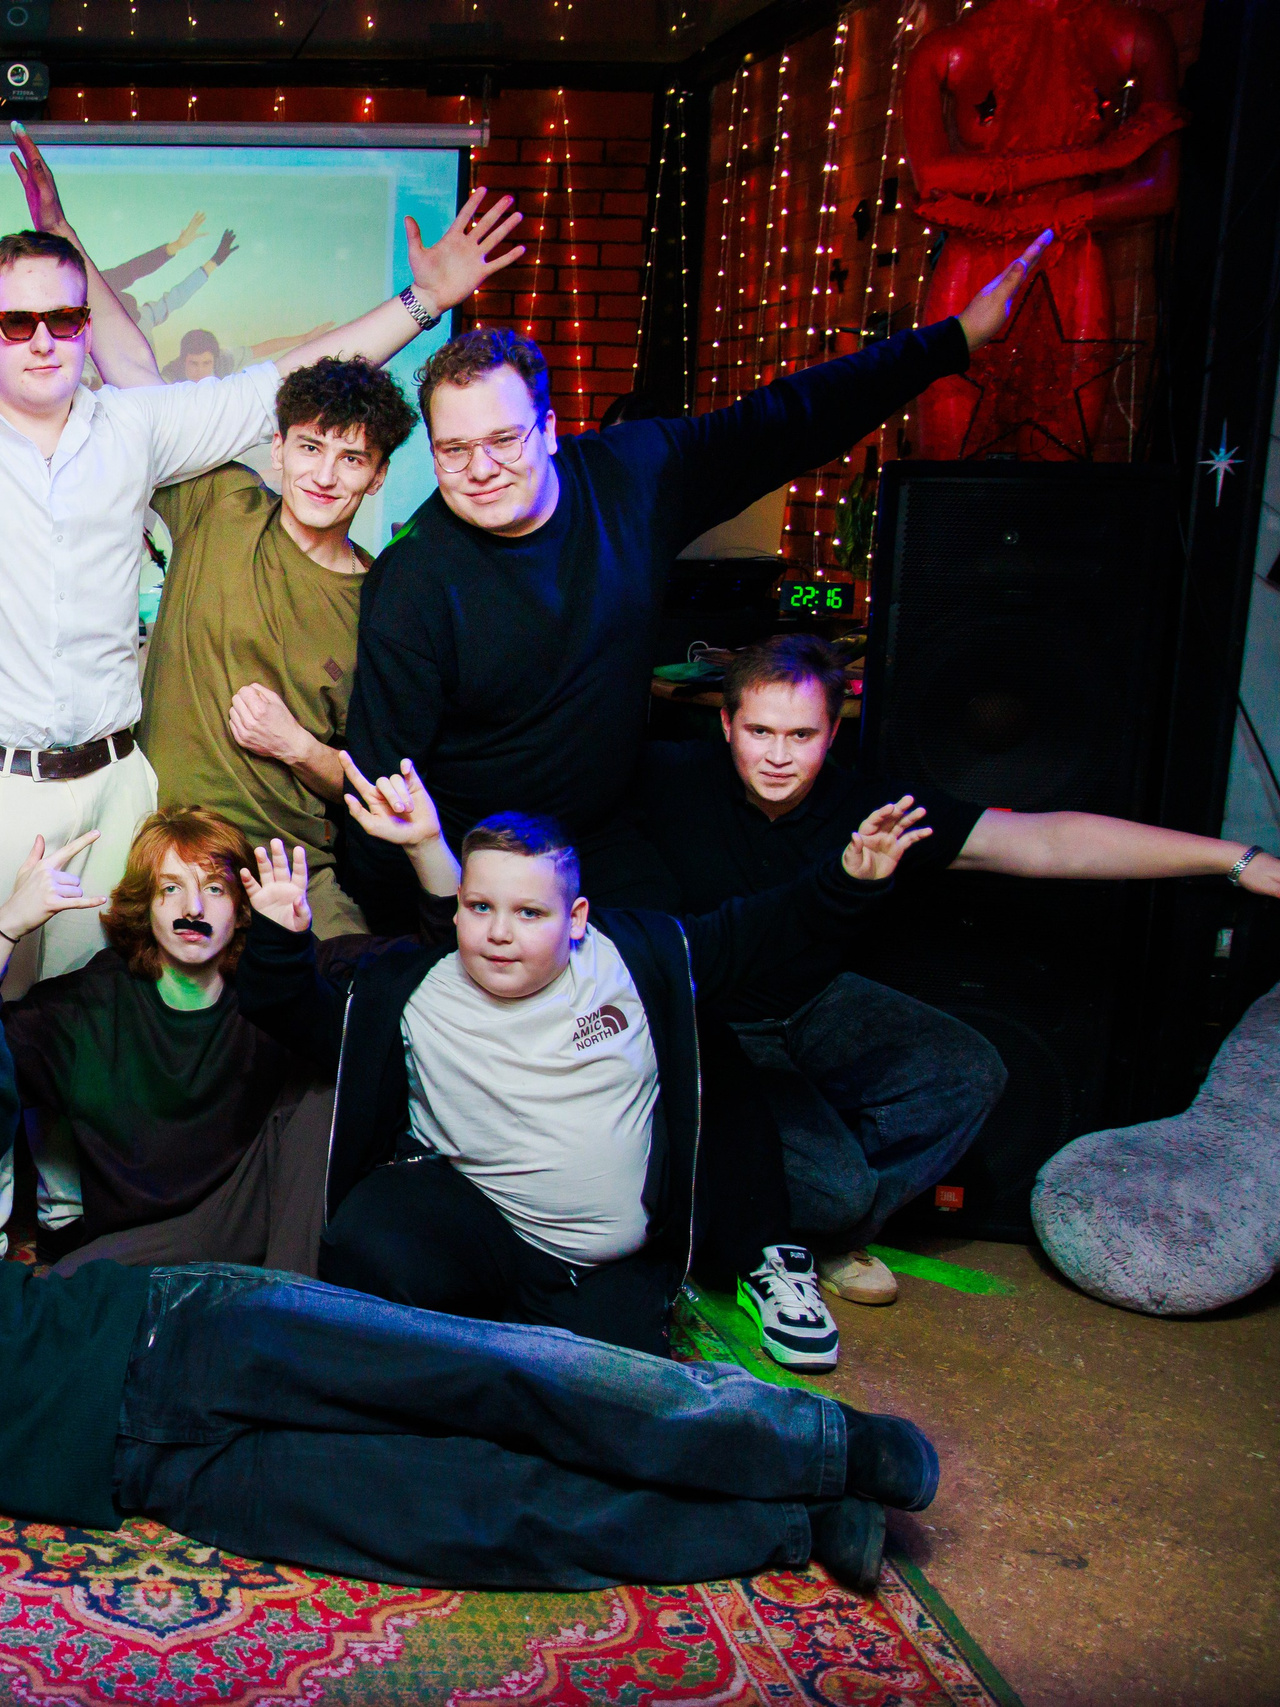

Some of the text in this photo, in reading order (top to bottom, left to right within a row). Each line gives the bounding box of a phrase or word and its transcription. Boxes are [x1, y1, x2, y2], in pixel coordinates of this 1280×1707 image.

[791, 586, 842, 609] 22:16
[576, 1010, 599, 1028] DYN
[572, 1020, 601, 1041] AMIC
[576, 1028, 612, 1051] NORTH
[940, 1190, 958, 1202] JBL
